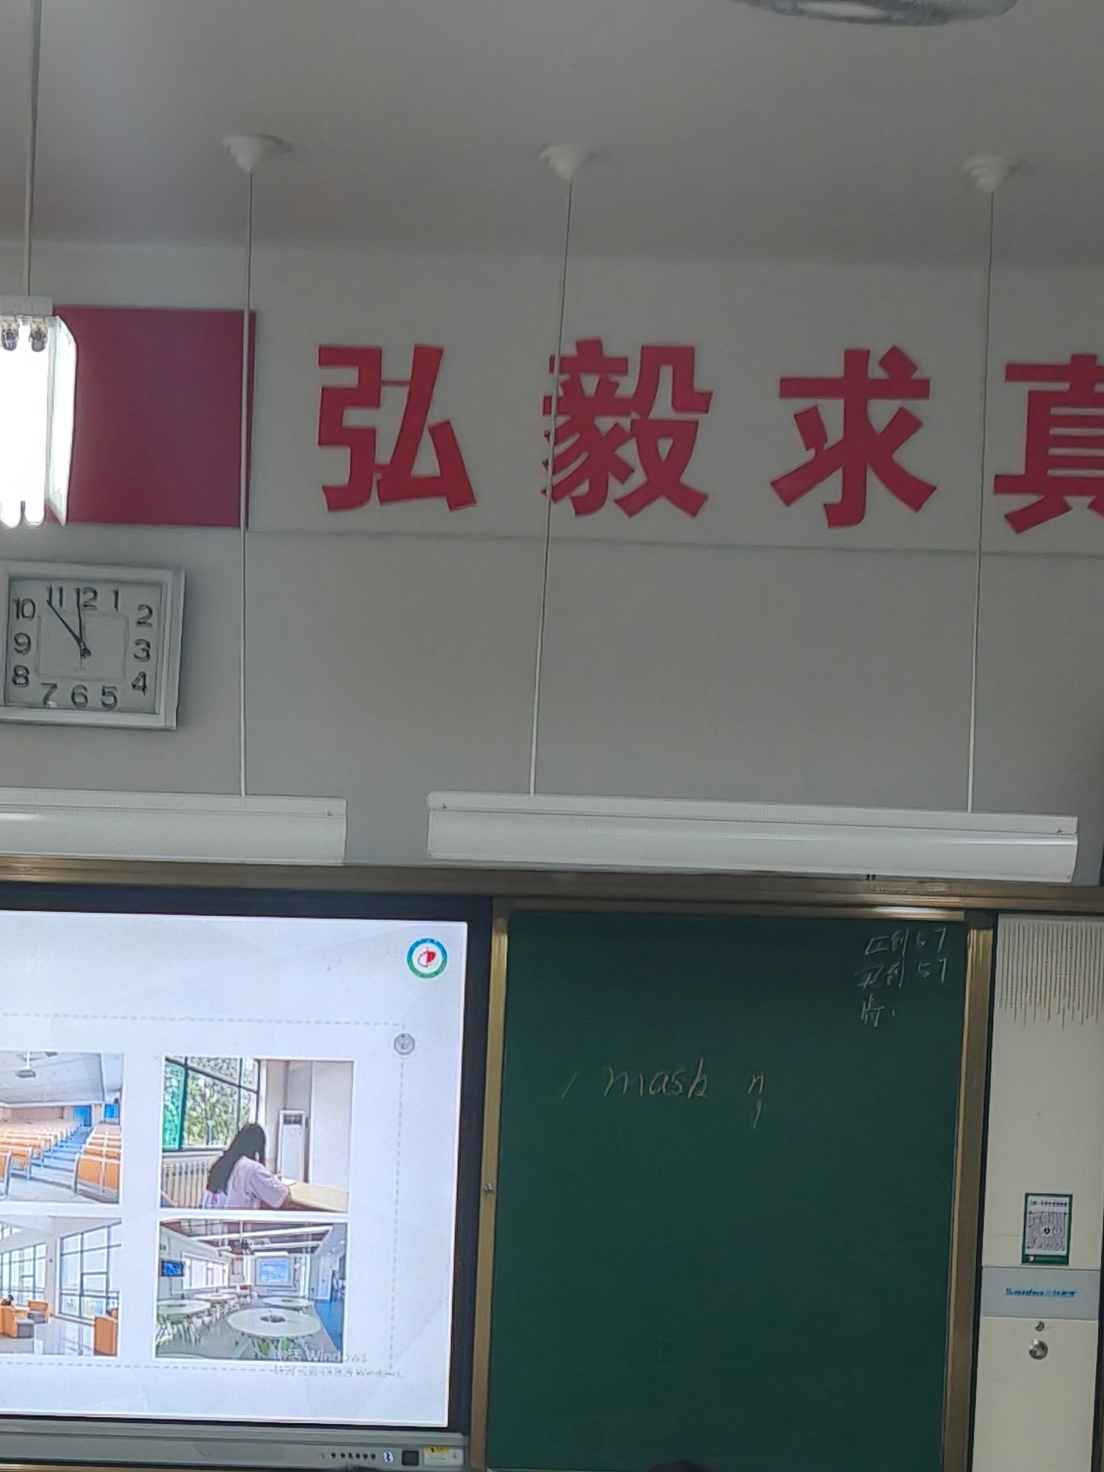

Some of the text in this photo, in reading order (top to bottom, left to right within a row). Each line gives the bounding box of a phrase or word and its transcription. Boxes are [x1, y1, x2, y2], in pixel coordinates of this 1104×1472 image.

[48, 584, 64, 607] 11
[75, 586, 98, 611] 12
[112, 589, 120, 611] 1
[13, 597, 36, 620] 10
[136, 603, 154, 627] 2
[13, 632, 32, 655] 9
[133, 638, 152, 662] 3
[11, 664, 30, 688] 8
[131, 671, 148, 696] 4
[40, 682, 58, 706] 7
[71, 684, 89, 708] 6
[100, 685, 118, 711] 5
